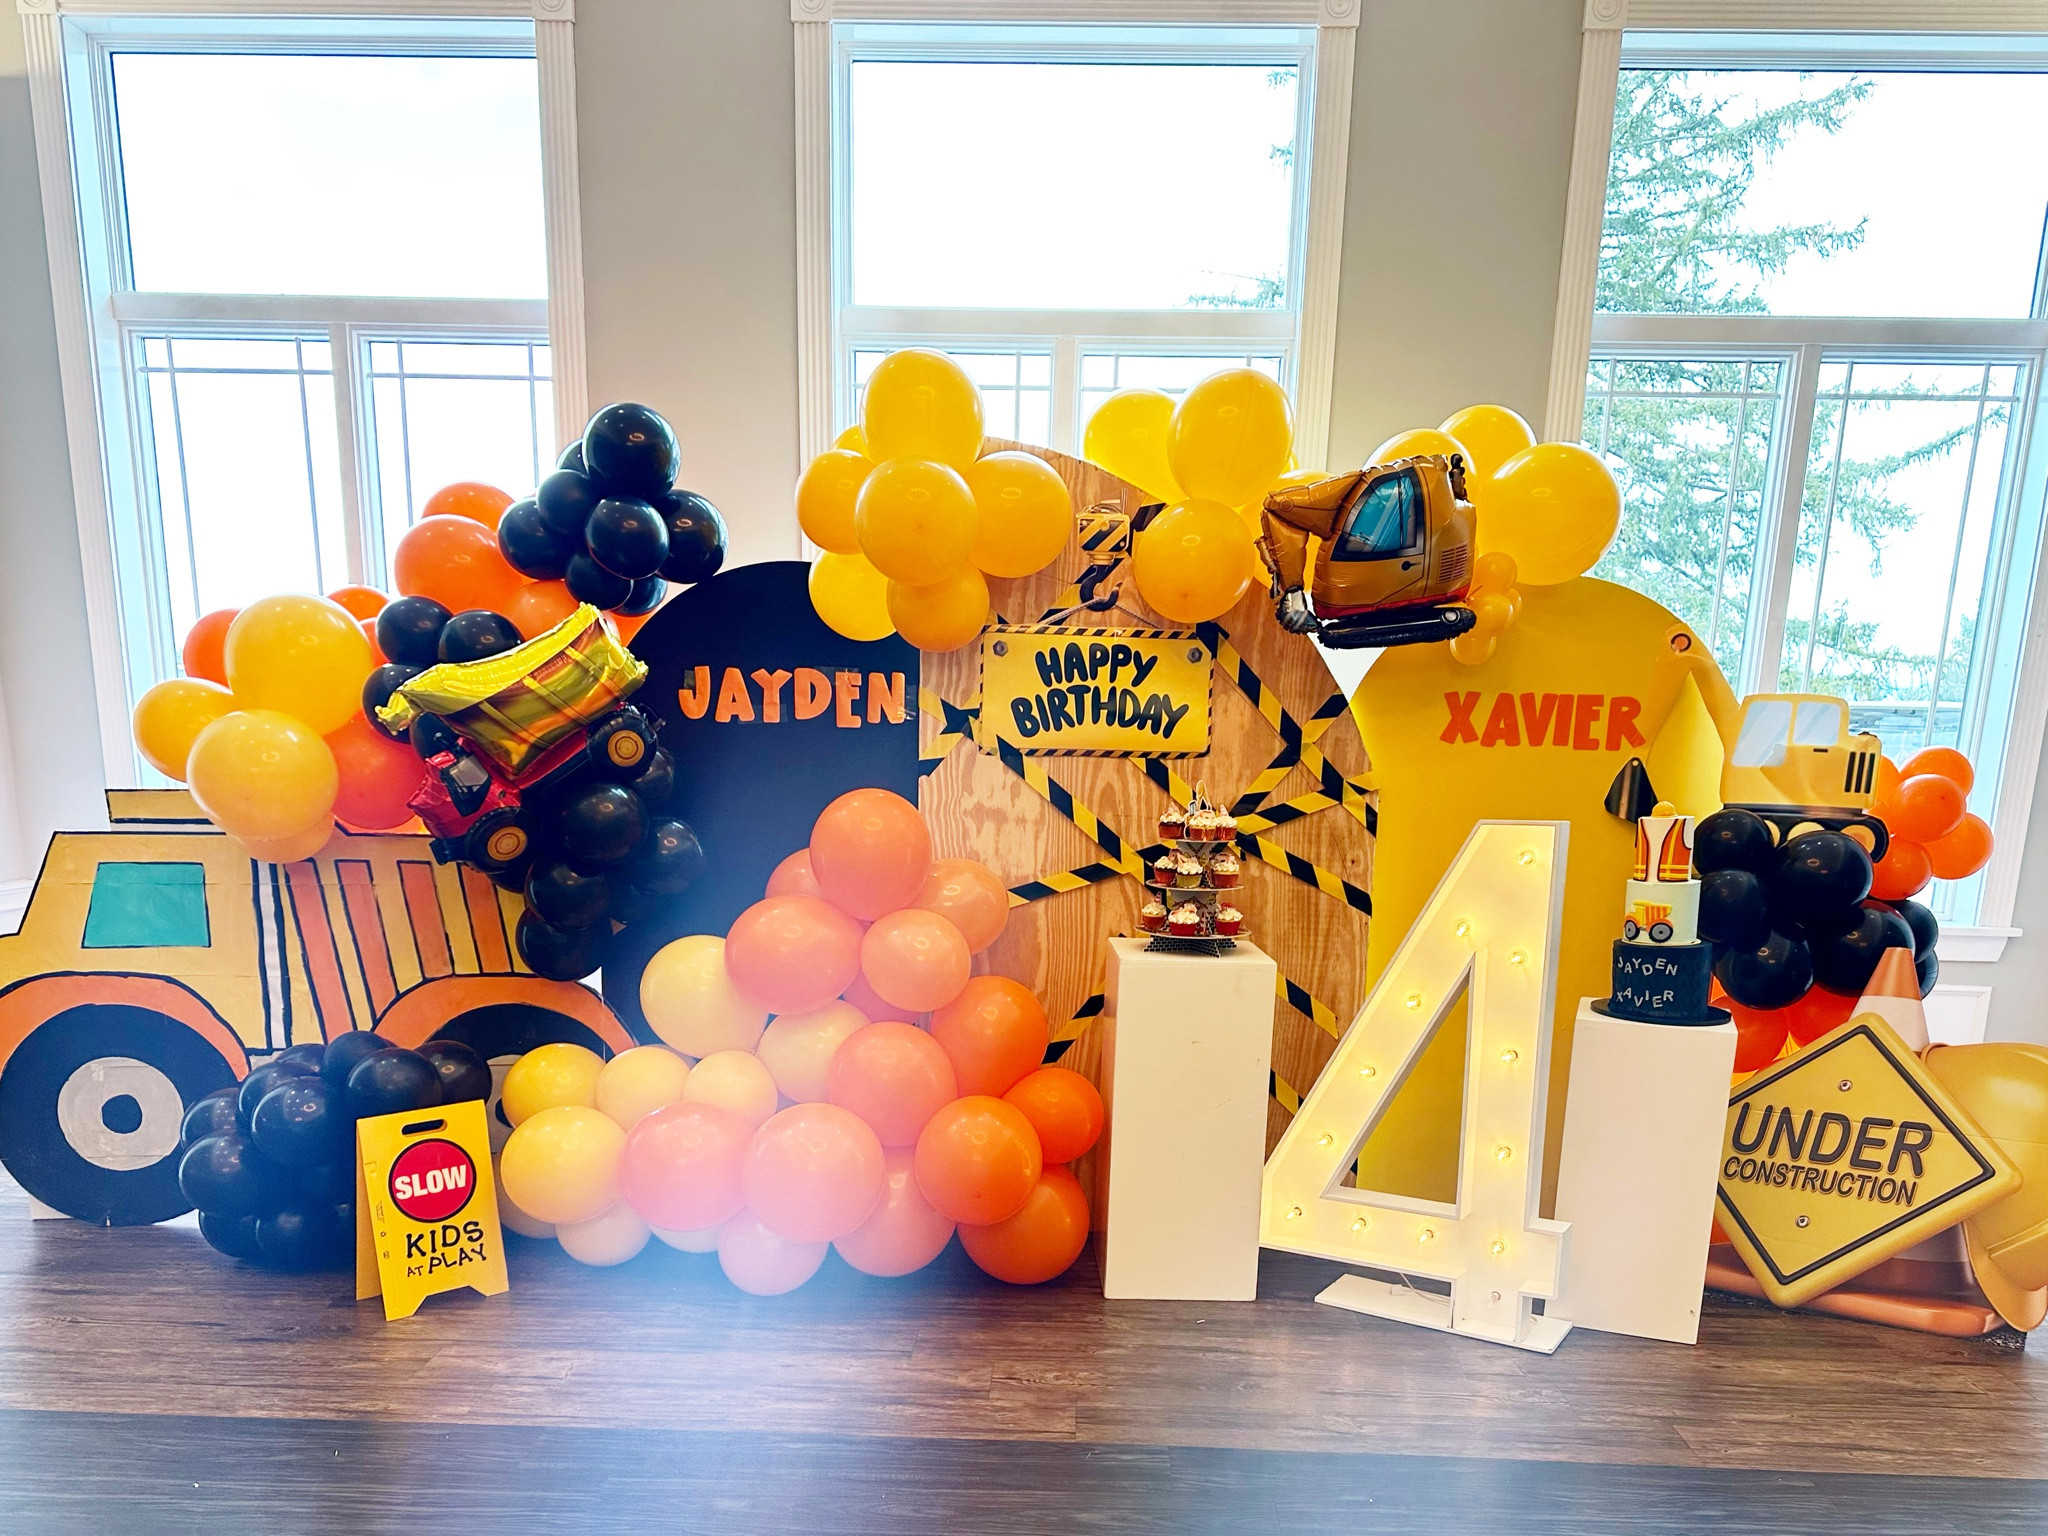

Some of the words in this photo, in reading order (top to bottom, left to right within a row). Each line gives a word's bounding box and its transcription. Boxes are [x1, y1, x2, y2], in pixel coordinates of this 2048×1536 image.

[1035, 642, 1158, 687] HAPPY
[678, 665, 905, 728] JAYDEN
[1010, 684, 1189, 739] BIRTHDAY
[1439, 690, 1646, 751] XAVIER
[1617, 956, 1679, 976] JAYDEN
[1616, 986, 1675, 1008] XAVIER
[1259, 820, 1571, 1342] 4
[1731, 1101, 1934, 1178] UNDER
[394, 1164, 467, 1200] SLOW
[1723, 1156, 1918, 1206] CONSTRUCTION
[406, 1220, 484, 1259] KIDS
[406, 1265, 424, 1278] AT
[428, 1243, 487, 1274] PLAY
